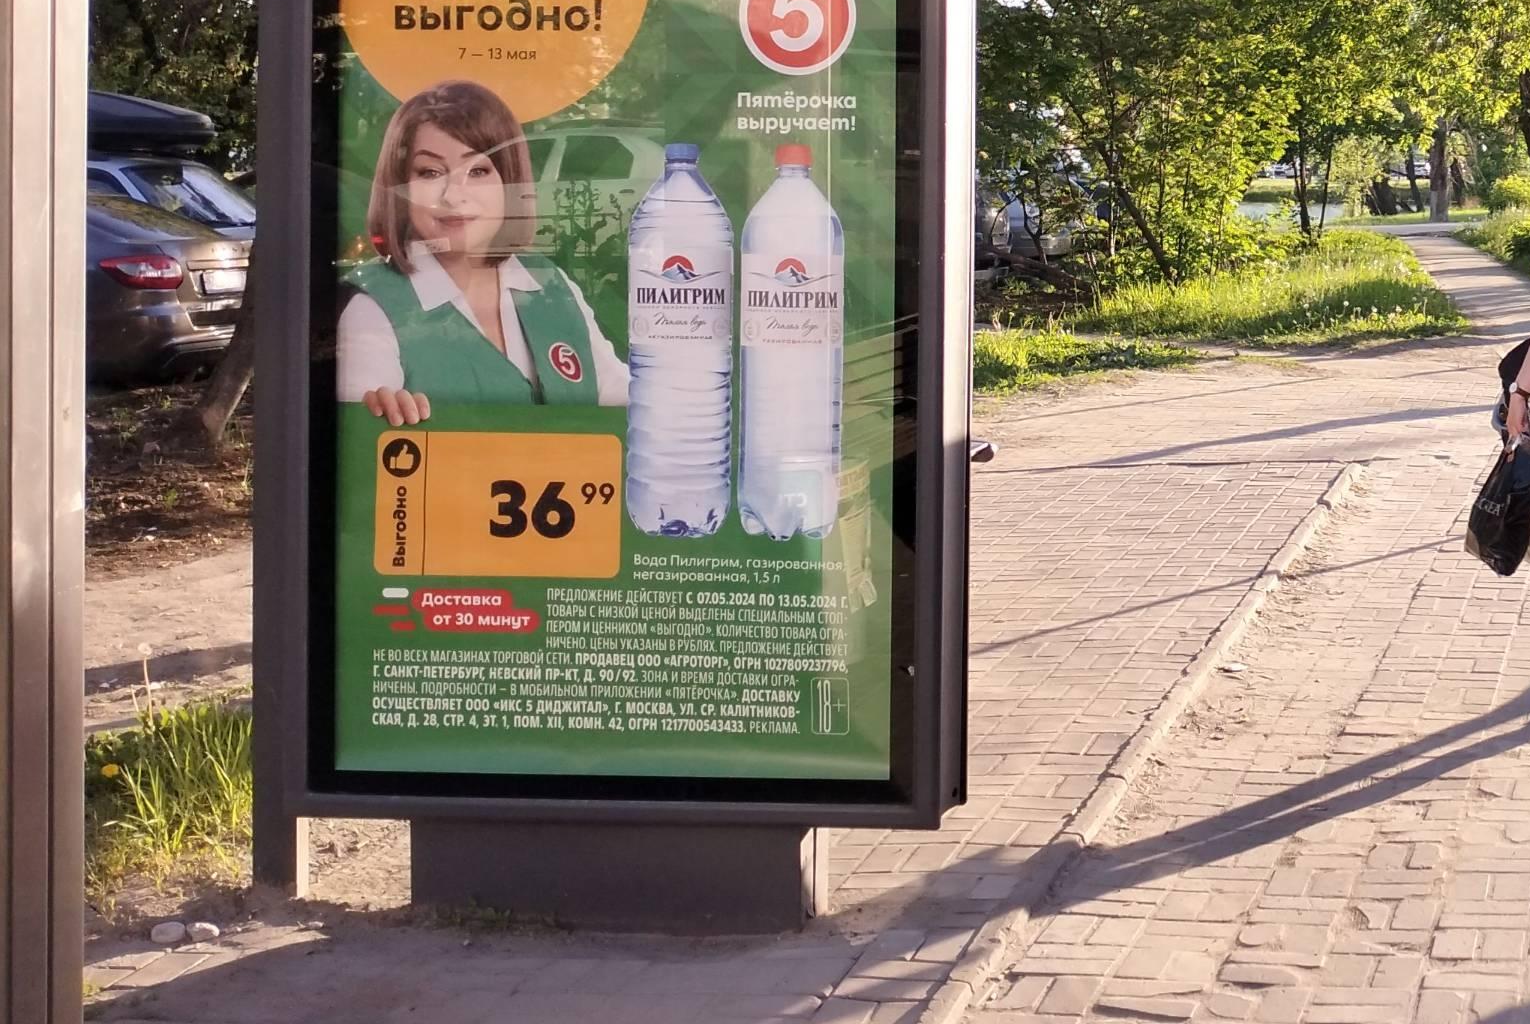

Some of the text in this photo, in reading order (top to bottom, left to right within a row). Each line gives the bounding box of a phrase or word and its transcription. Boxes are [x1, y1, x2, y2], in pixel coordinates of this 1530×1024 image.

[458, 48, 467, 60] 7
[488, 48, 502, 60] 13
[506, 50, 537, 60] мая
[737, 90, 857, 112] Пятёрочка
[737, 115, 857, 134] выручает!
[636, 287, 726, 305] ПИЛИГРИМ
[747, 290, 838, 308] ПИЛИГРИМ
[558, 346, 576, 376] 5
[489, 479, 615, 539] 36 99
[392, 485, 407, 567] Выгодно
[634, 554, 667, 568] Вода
[670, 555, 743, 570] Пилигрим,
[633, 569, 781, 584] негазированная, 1,5 л
[421, 592, 502, 608] Доставка
[547, 588, 848, 608] ПРЕДЛОЖЕНИЕ ДЕЙСТВУЕТ С 07.05.2024 ПО 13.05.2024 Г.
[433, 613, 530, 629] от 30 минут
[547, 603, 848, 624] ТОВАРЫ С НИЗКОЙ ЦЕНОЙ ВЫДЕЛЕНЫ СПЕЦИАЛЬНЫМ СТОП-
[546, 620, 848, 640] ПЕРОМ И ЦЕННИКОМ «ВЫГОДНО». КОЛИЧЕСТВО ТОВАРА ОГРА-
[546, 636, 848, 656] НИЧЕНО. ЦЕНЫ УКАЗАНЫ В РУБЛЯХ. ПРЕДЛОЖЕНИЕ ДЕЙСТВУЕТ
[373, 649, 386, 661] НЕ
[388, 649, 401, 662] ВО
[404, 650, 428, 662] ВСЕХ
[430, 650, 490, 663] МАГАЗИНАХ
[493, 649, 544, 664] ТОРГОВОЙ
[546, 652, 573, 665] СЕТИ.
[575, 652, 635, 668] ПРОДАВЕЦ
[637, 654, 661, 666] ООО
[664, 655, 730, 670] «АГРОТОРГ»,
[734, 657, 761, 670] ОГРН
[373, 665, 380, 677] Г.
[384, 665, 485, 681] САНКТ-ПЕТЕРБУРГ,
[489, 665, 541, 680] НЕВСКИЙ
[545, 668, 580, 682] ПР-КТ,
[584, 669, 596, 682] Д.
[641, 670, 668, 683] ЗОНА
[671, 671, 679, 683] И
[681, 671, 714, 684] ВРЕМЯ
[717, 673, 768, 687] ДОСТАВКИ
[771, 674, 799, 687] ОГРА-
[373, 681, 418, 694] НИЧЕНЫ.
[421, 682, 496, 696] ПОДРОБНОСТИ
[510, 683, 517, 695] В
[520, 684, 588, 696] МОБИЛЬНОМ
[590, 685, 662, 698] ПРИЛОЖЕНИИ
[742, 689, 800, 703] ДОСТАВКУ
[372, 697, 800, 718] ОСУЩЕСТВЛЯЕТ ООО «ИКС 5 ДИДЖИТАЛ», Г. МОСКВА, УЛ. СР. КАЛИТНИКОВ-
[817, 679, 846, 733] 18+
[372, 713, 403, 727] СКАЯ,
[407, 714, 419, 728] Д.
[423, 714, 440, 728] 28,
[443, 714, 466, 727] СТР.
[469, 715, 479, 729] 4,
[483, 715, 498, 728] ЭТ.
[502, 715, 510, 729] 1,
[514, 716, 543, 729] ПОМ.
[568, 717, 604, 729] КОМН.
[608, 717, 625, 731] 42,
[628, 718, 658, 731] ОГРН
[750, 721, 800, 734] РЕКЛАМА.
